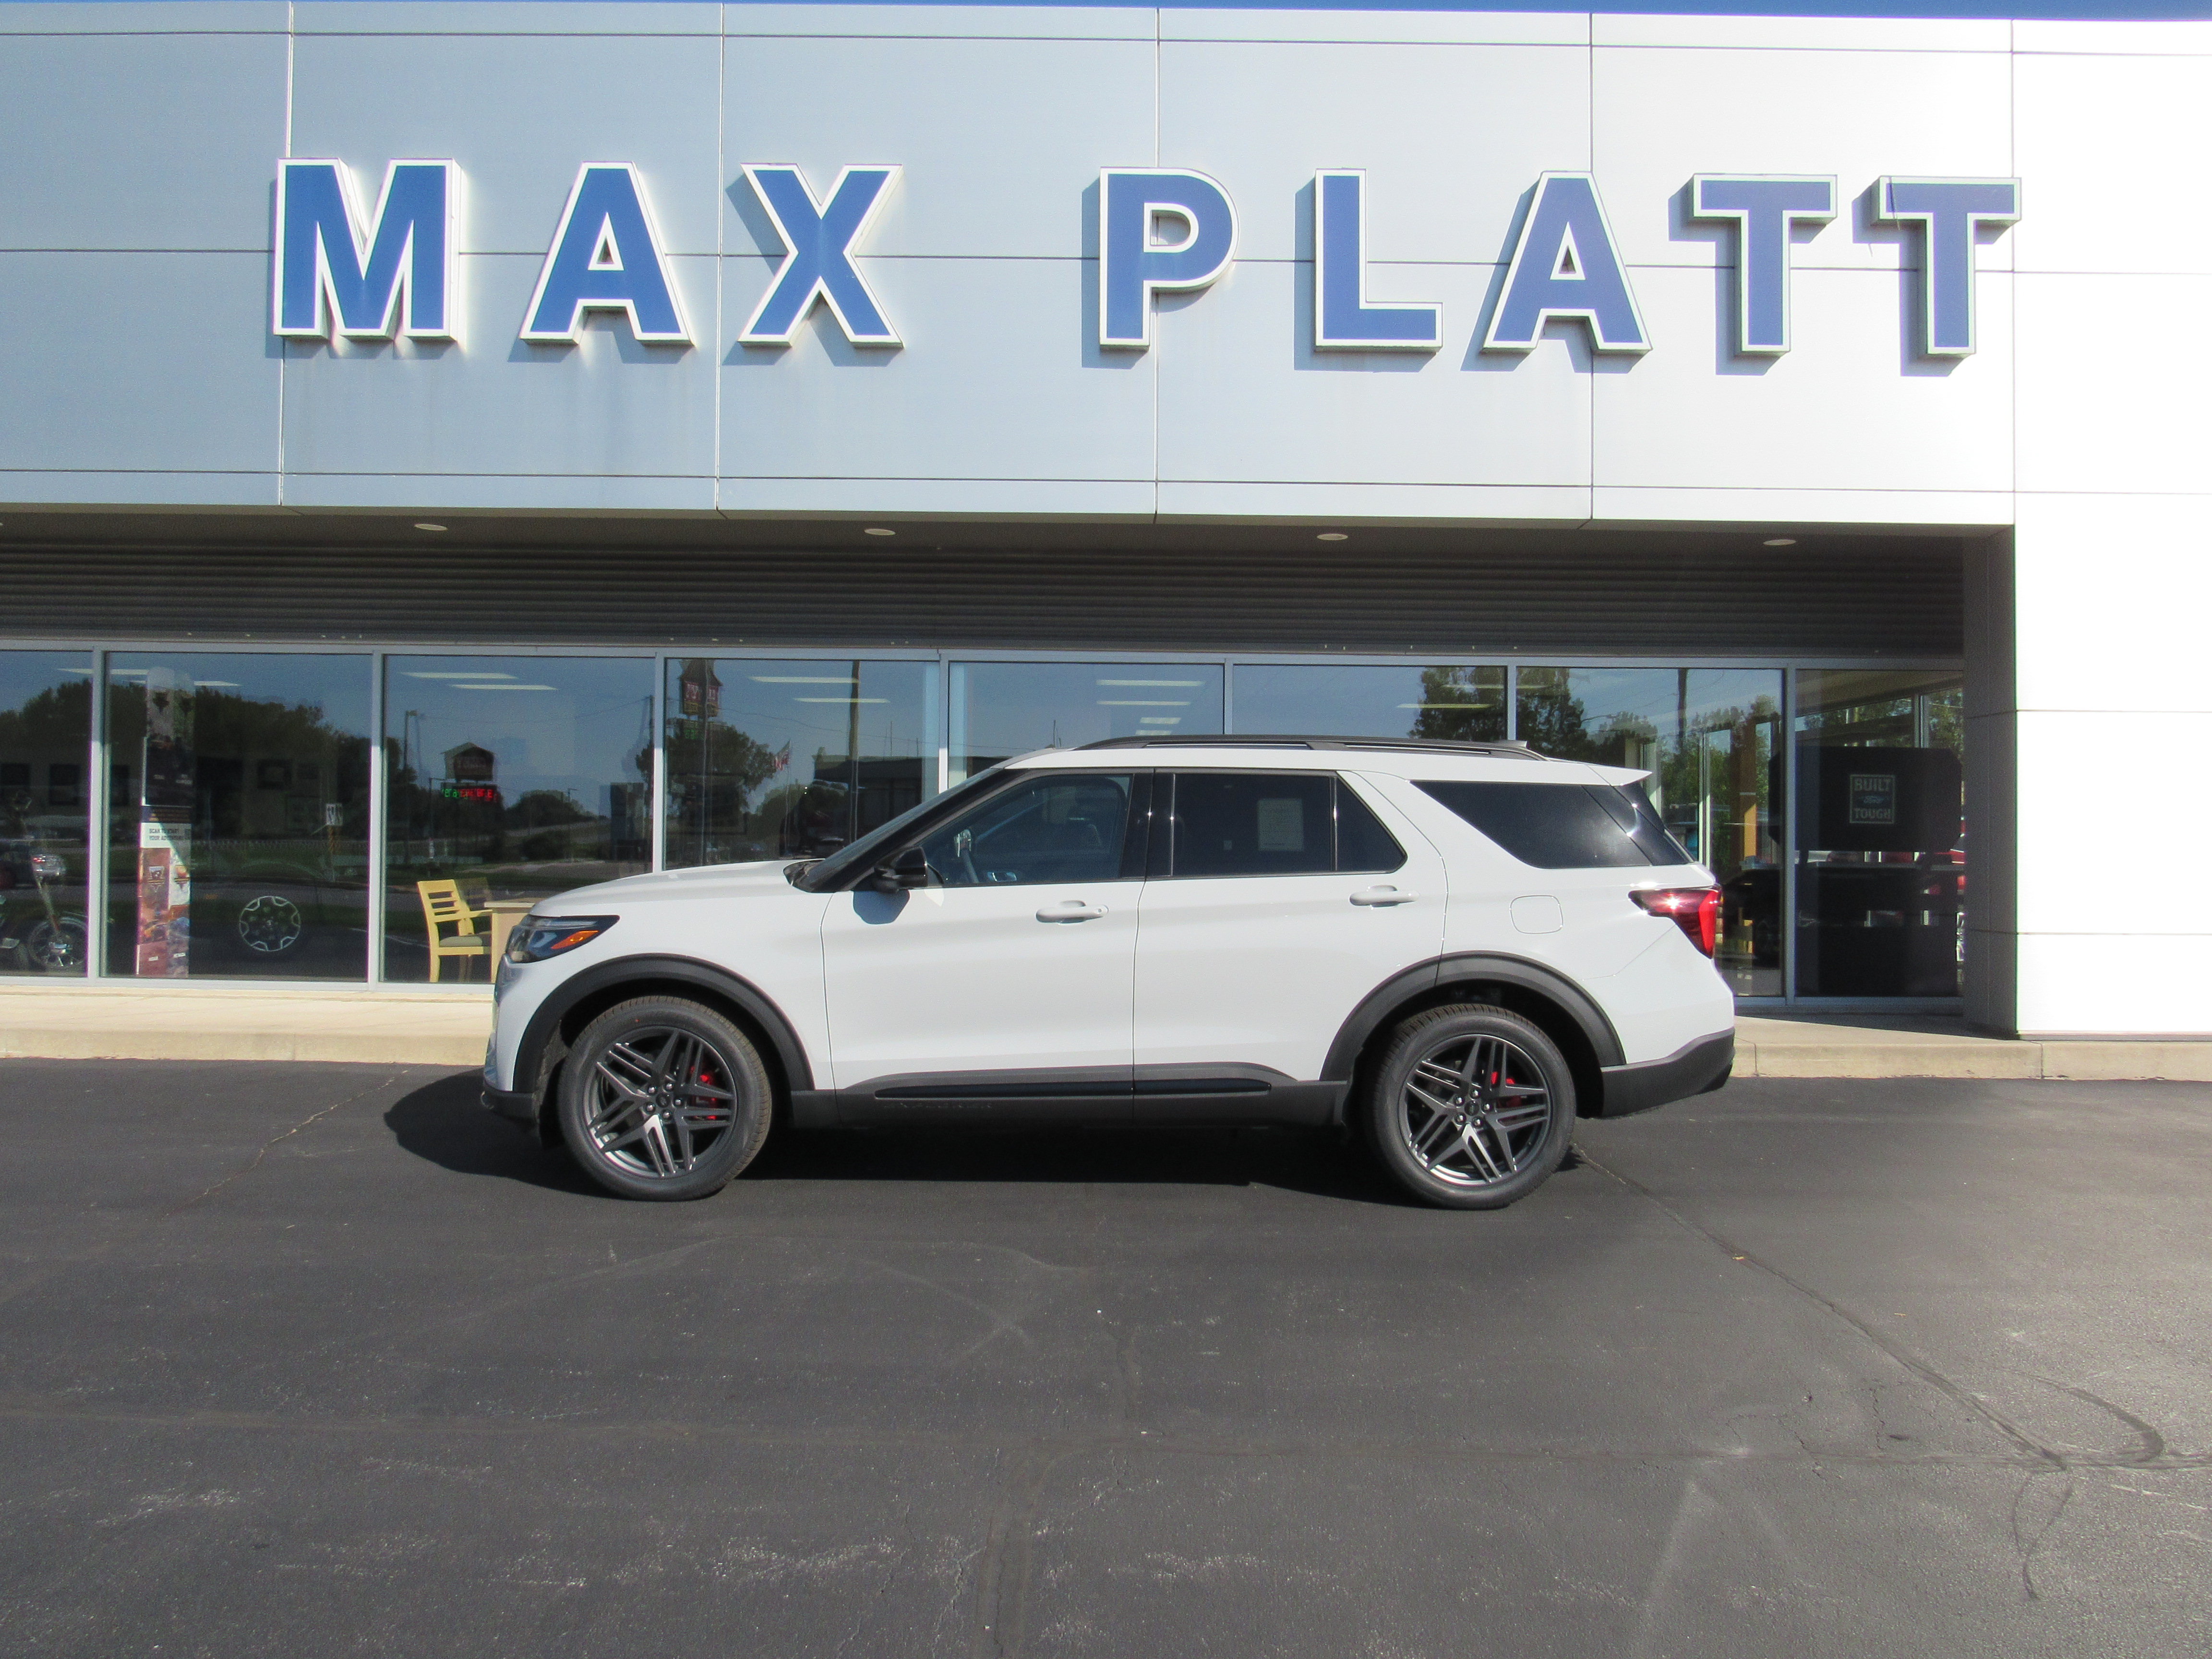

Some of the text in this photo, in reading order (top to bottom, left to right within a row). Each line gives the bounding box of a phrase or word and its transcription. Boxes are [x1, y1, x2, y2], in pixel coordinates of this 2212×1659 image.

[274, 158, 2021, 356] MAX PLATT
[1854, 778, 1891, 792] BUILT
[1853, 808, 1891, 818] TOUGH
